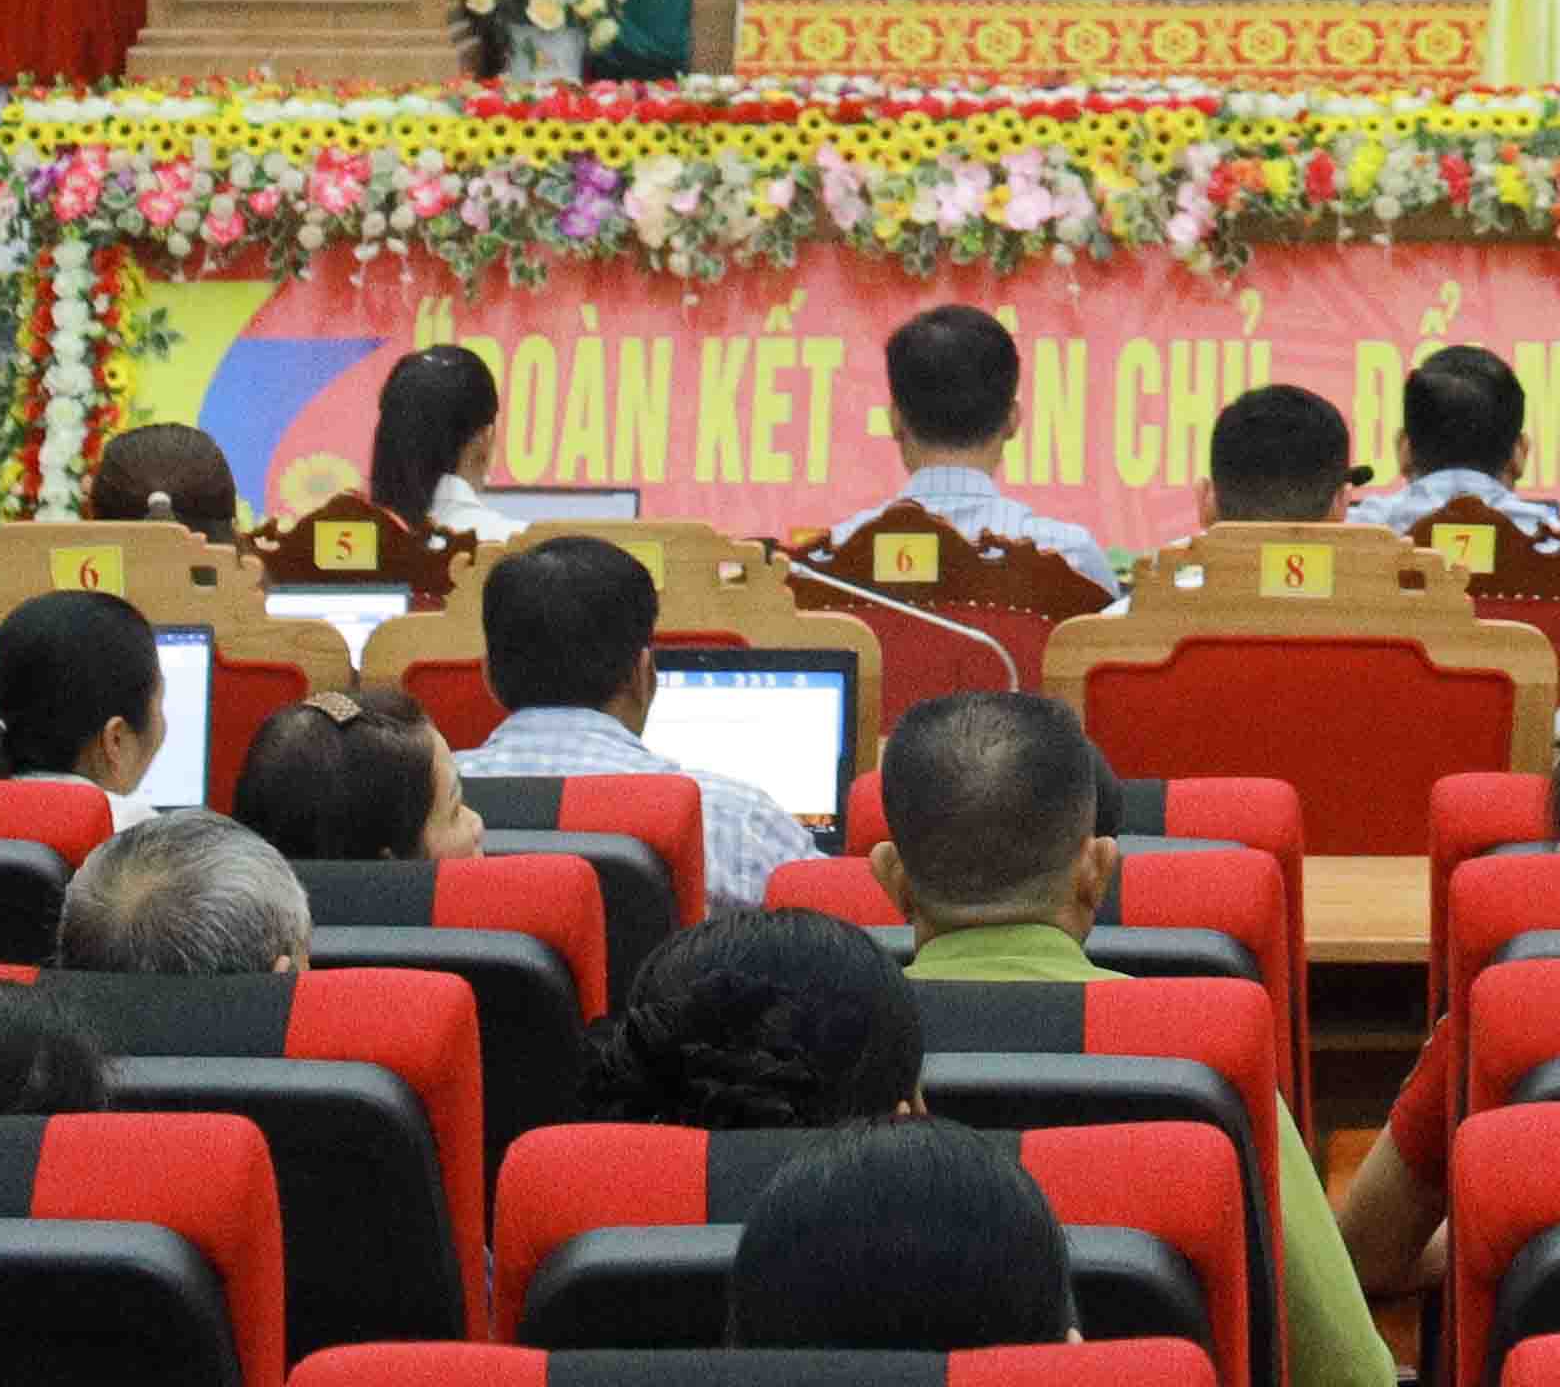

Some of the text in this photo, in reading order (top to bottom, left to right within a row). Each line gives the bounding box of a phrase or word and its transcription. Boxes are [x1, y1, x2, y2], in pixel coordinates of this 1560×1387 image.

[696, 288, 844, 484] KẾT
[336, 529, 354, 559] 5
[896, 541, 912, 573] 6
[1455, 533, 1472, 562] 7
[1284, 554, 1306, 588] 8
